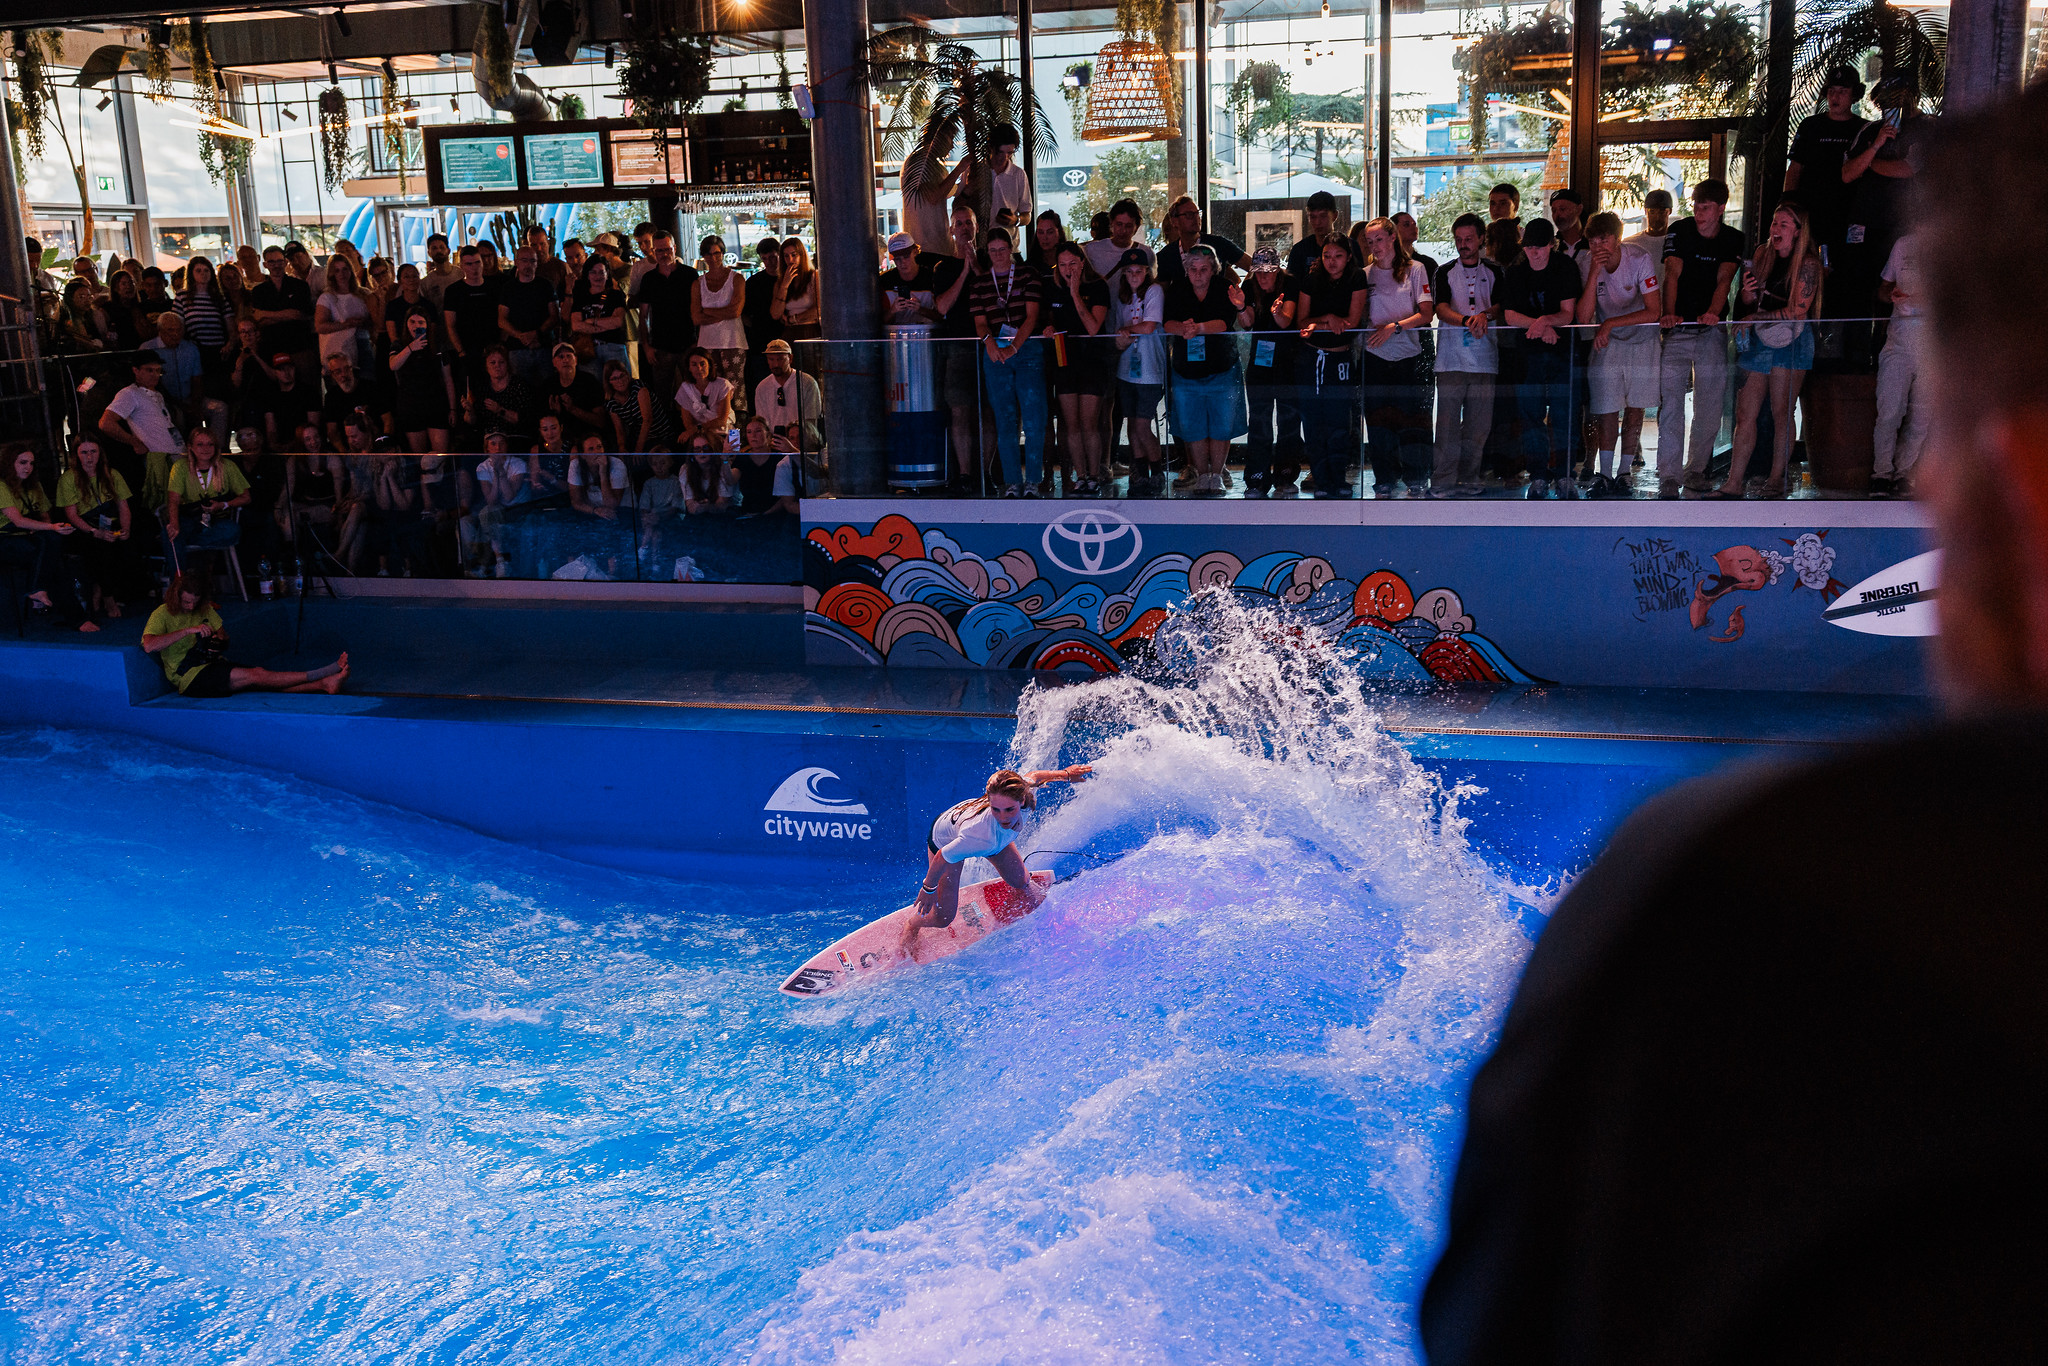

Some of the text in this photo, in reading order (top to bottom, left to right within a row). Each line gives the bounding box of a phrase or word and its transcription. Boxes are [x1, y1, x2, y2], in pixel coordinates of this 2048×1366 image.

[1338, 362, 1350, 381] 87
[1625, 537, 1676, 558] DUDE
[1629, 555, 1662, 576] THAT
[1635, 587, 1689, 615] BLOWING
[1860, 581, 1919, 603] LISTERINE
[1876, 605, 1906, 617] MYSTIC
[764, 813, 872, 841] citywave
